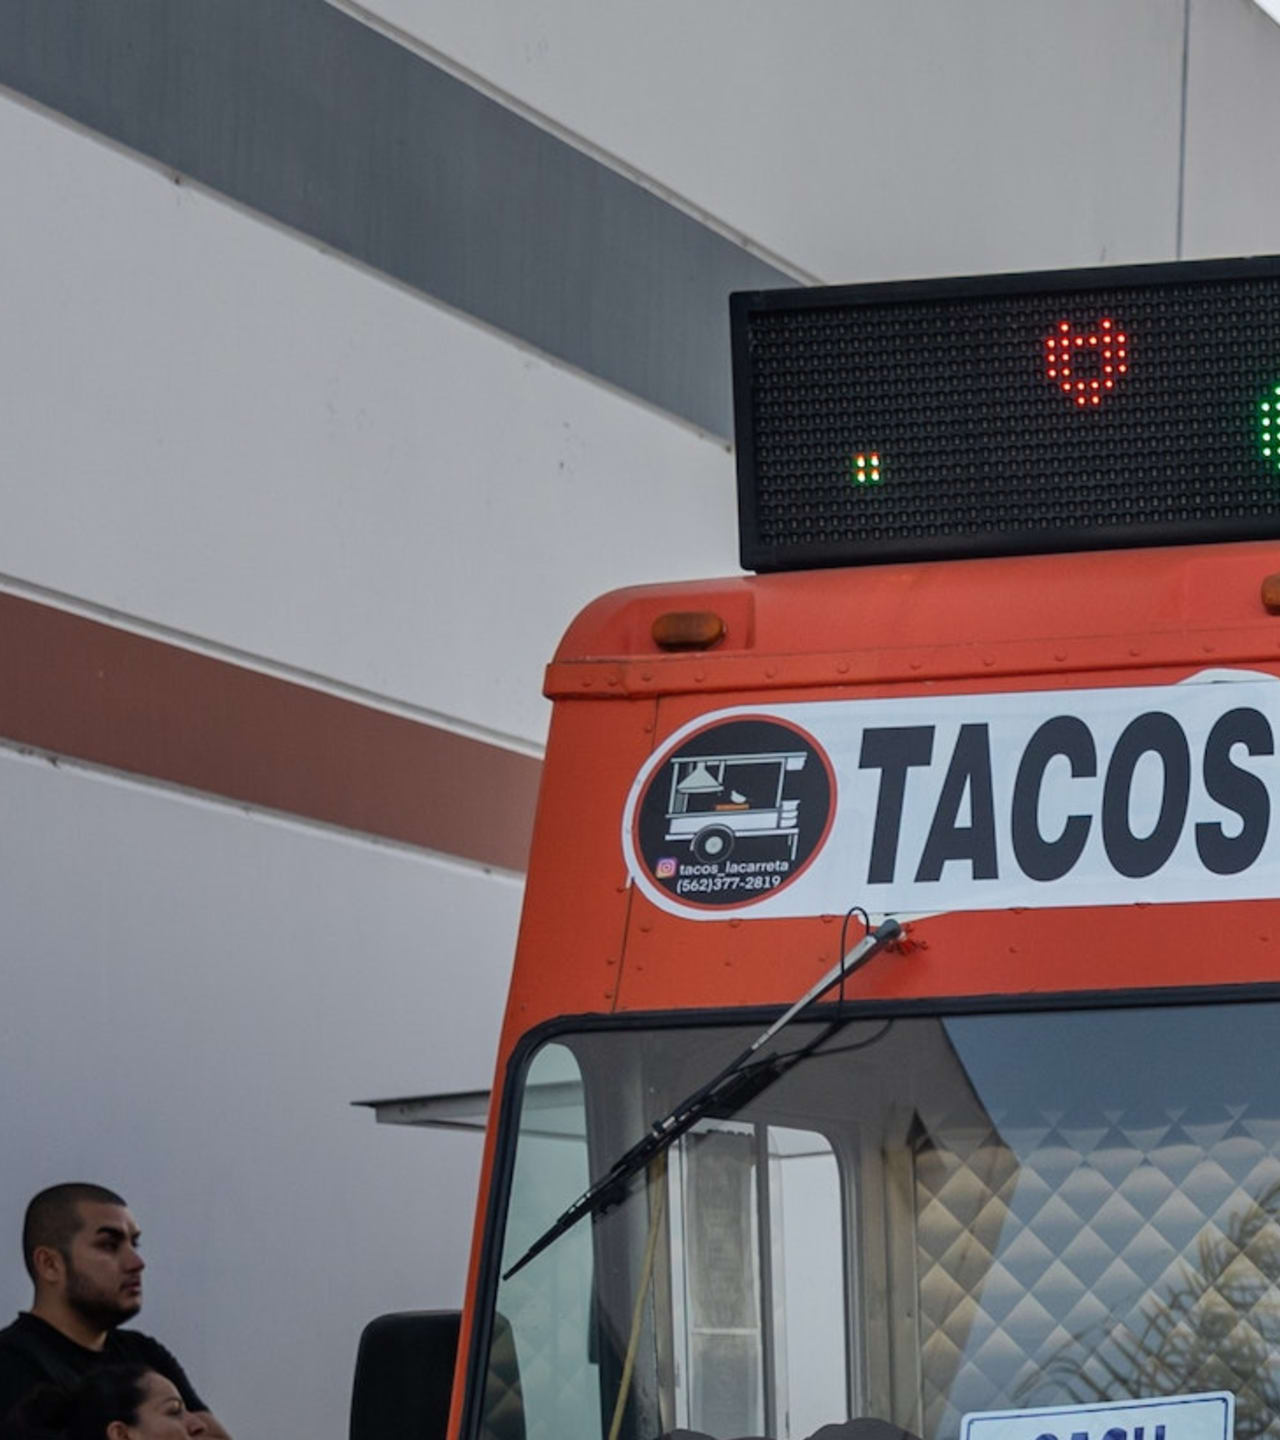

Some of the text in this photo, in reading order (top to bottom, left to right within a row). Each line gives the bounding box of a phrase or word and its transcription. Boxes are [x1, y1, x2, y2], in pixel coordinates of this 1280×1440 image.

[858, 706, 1275, 885] TACOS
[679, 860, 790, 878] tacos_lacarreta
[676, 875, 782, 894] (562)377-2819
